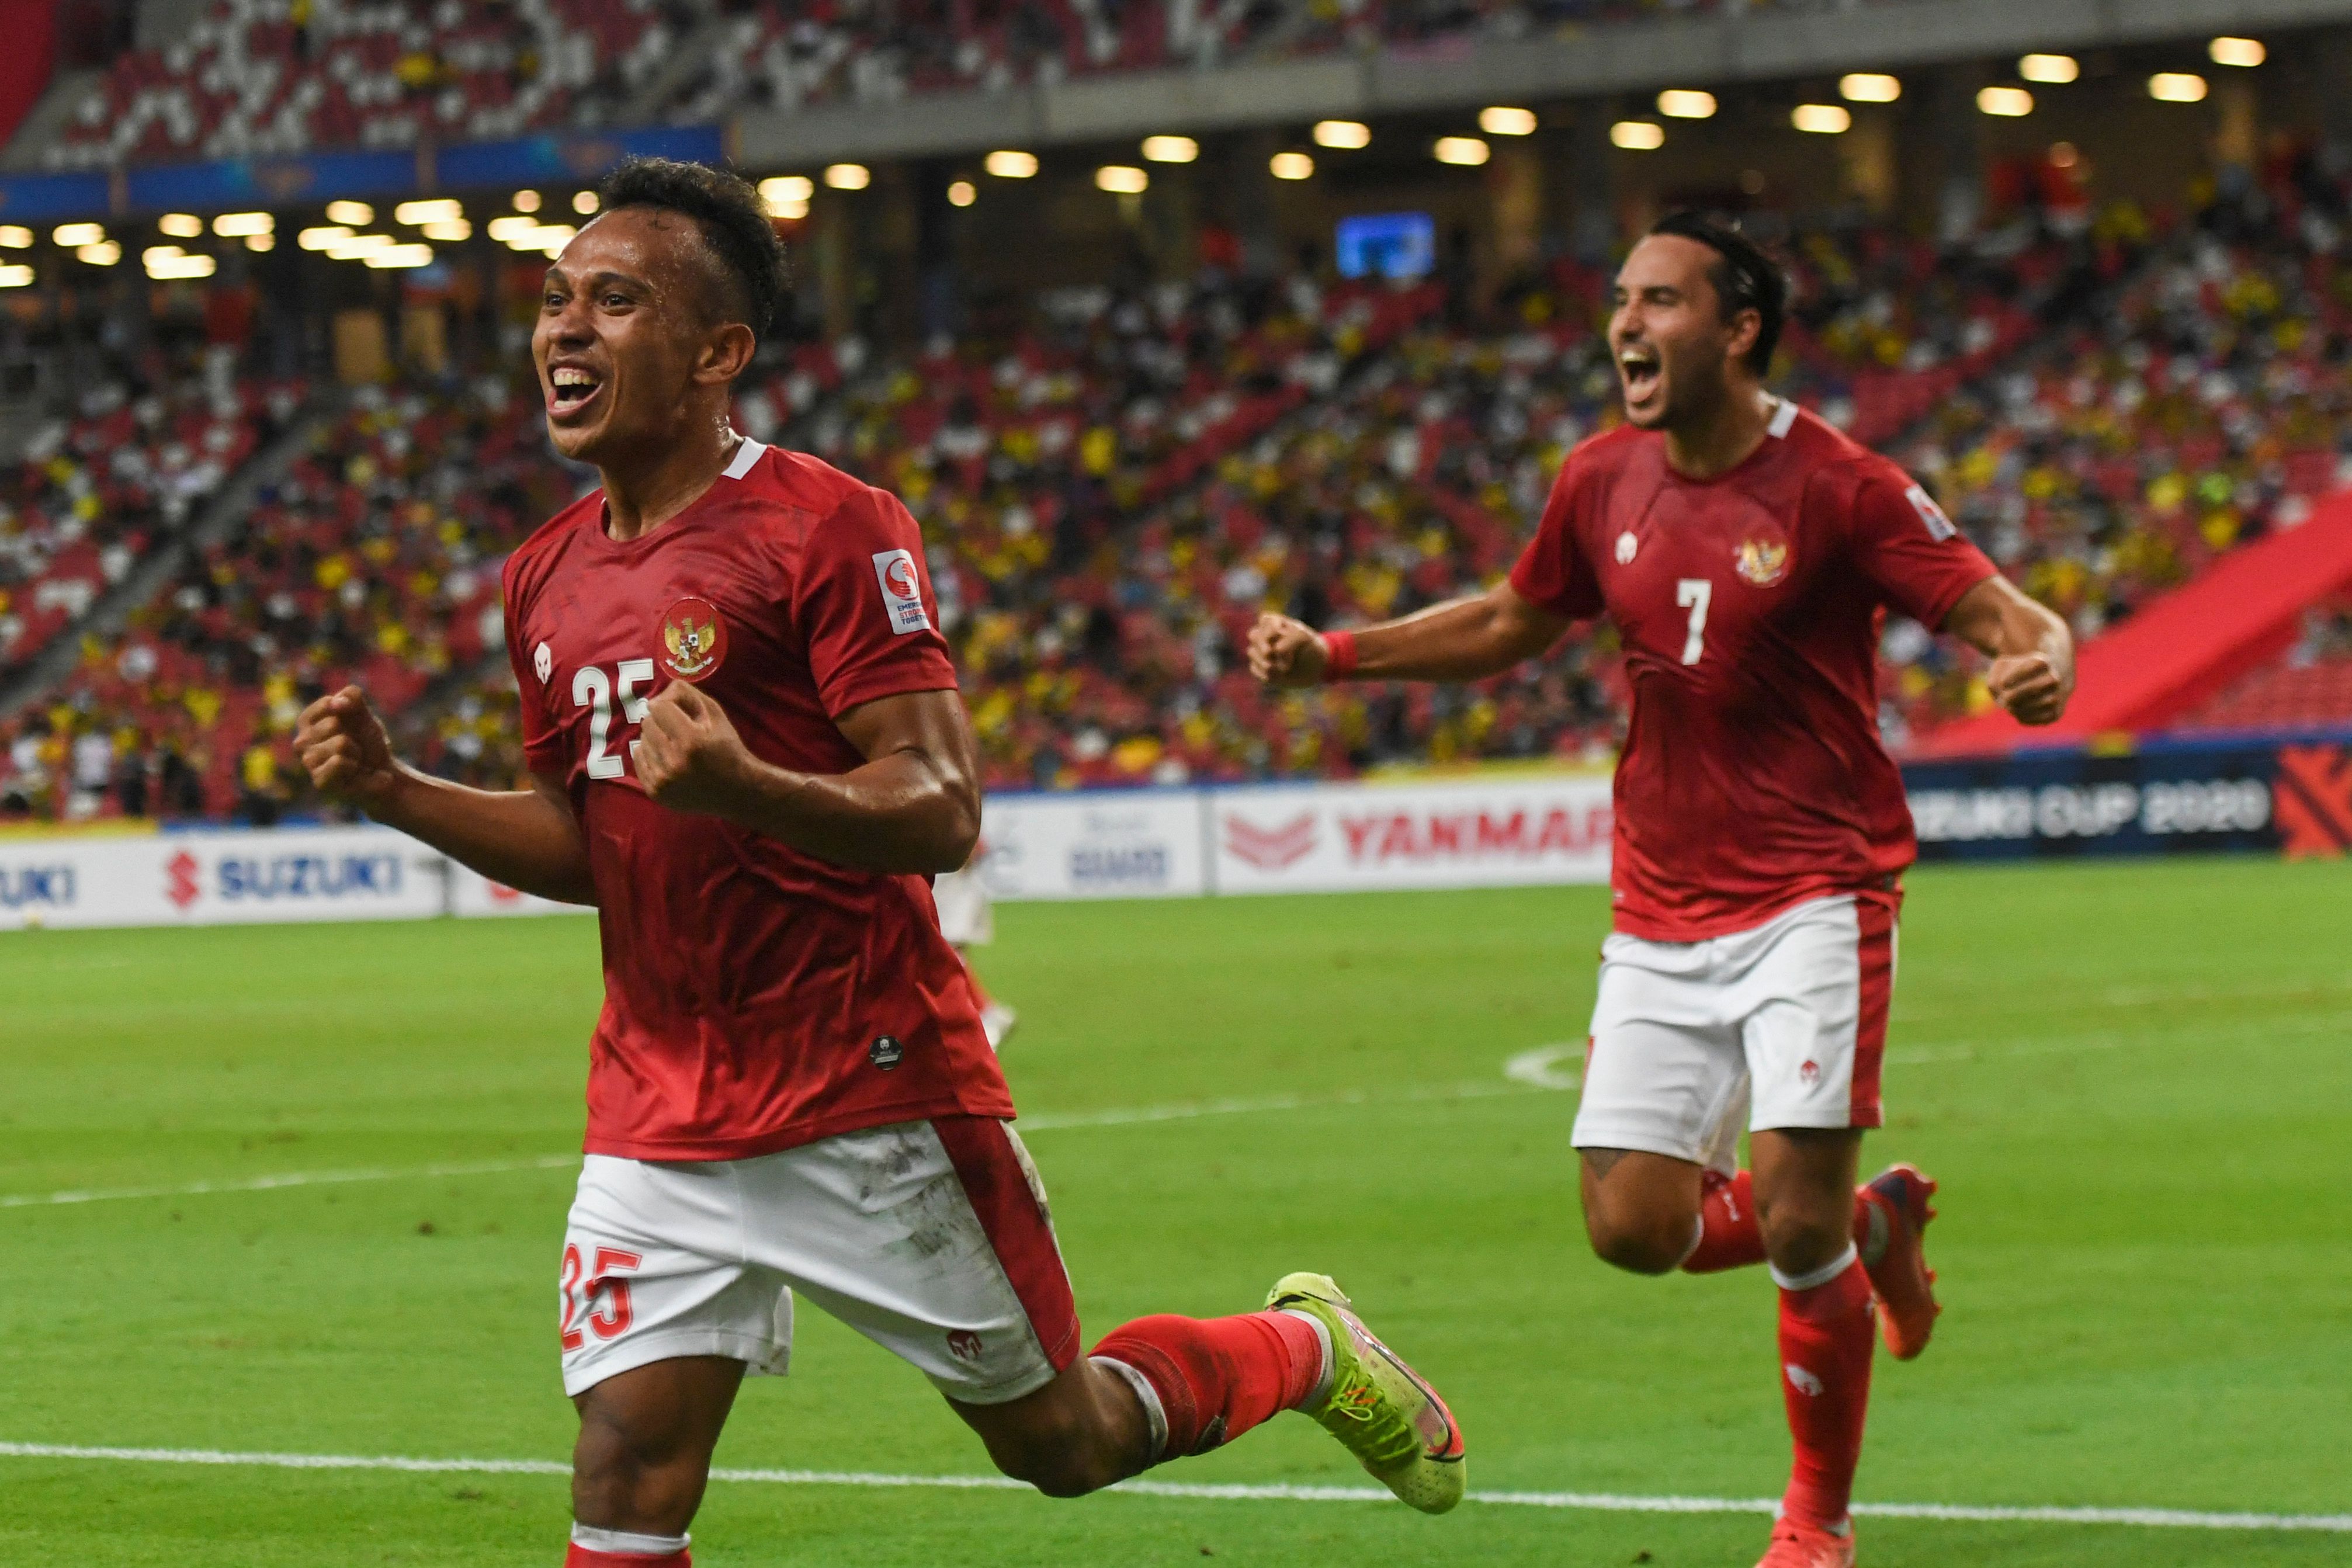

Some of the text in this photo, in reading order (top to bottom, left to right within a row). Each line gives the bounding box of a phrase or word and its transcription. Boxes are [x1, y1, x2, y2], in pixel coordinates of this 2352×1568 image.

[899, 608, 924, 619] STRON
[901, 615, 925, 625] TOGET
[1677, 578, 1712, 665] 7
[2035, 785, 2139, 838] CUP
[2143, 778, 2271, 834] 2020
[217, 852, 403, 899] SUZUKI
[561, 1243, 643, 1354] 25
